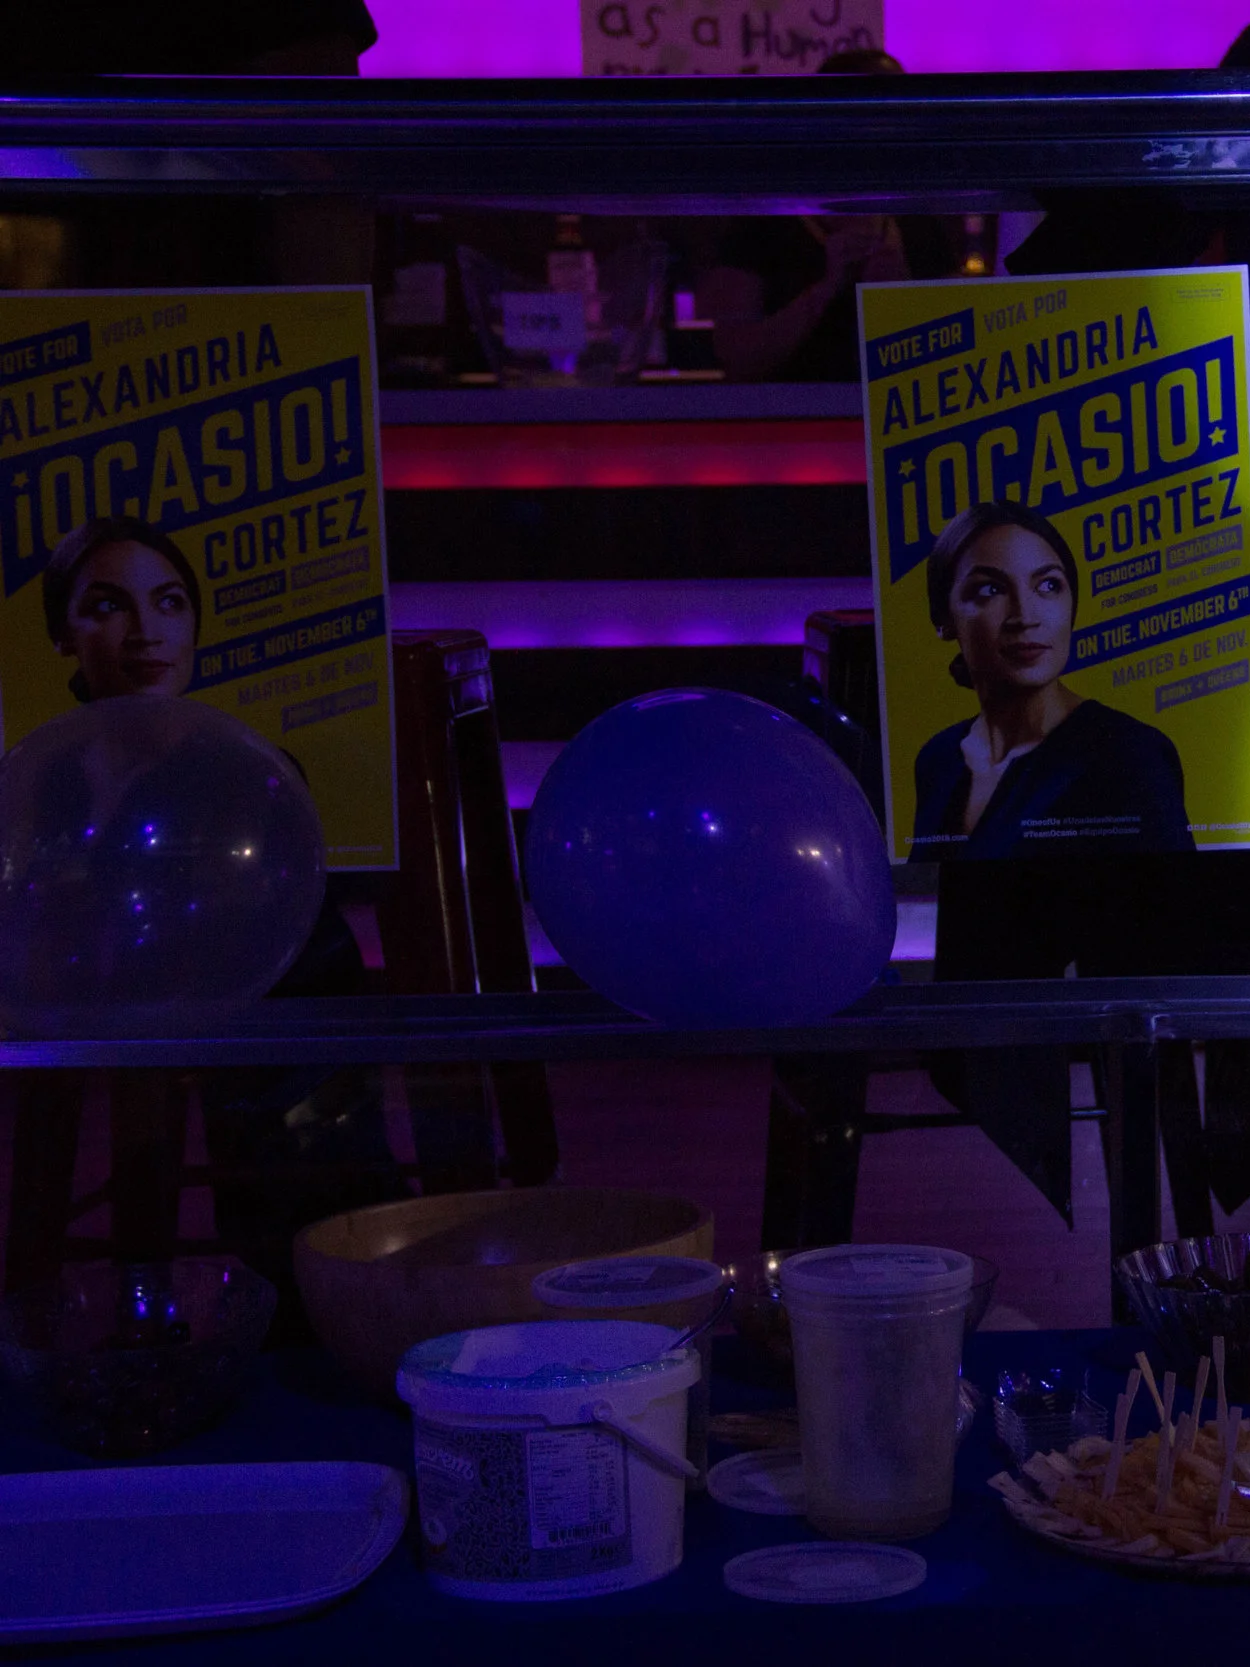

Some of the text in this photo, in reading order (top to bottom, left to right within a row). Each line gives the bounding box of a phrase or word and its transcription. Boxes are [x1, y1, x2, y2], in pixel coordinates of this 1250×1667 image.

[598, 4, 665, 49] as
[692, 15, 721, 48] a
[152, 303, 187, 331] POR
[984, 288, 1068, 334] VOTA POR
[0, 334, 79, 377] OTE FOR
[877, 322, 963, 369] VOTE FOR
[882, 305, 1159, 436] ALEXANDRIA
[0, 323, 282, 446] ALEXANDRIA
[205, 489, 368, 579] CORTEZ
[1083, 467, 1242, 562] CORTEZ
[1095, 555, 1157, 589] DEMOCRAT
[200, 653, 222, 678] ON
[264, 615, 354, 658] NOVEMBER
[1076, 586, 1250, 660] ON TUE. NOVEMBER 6TH
[1112, 652, 1175, 689] MARTES
[1179, 647, 1188, 666] 6
[1193, 639, 1213, 662] DE
